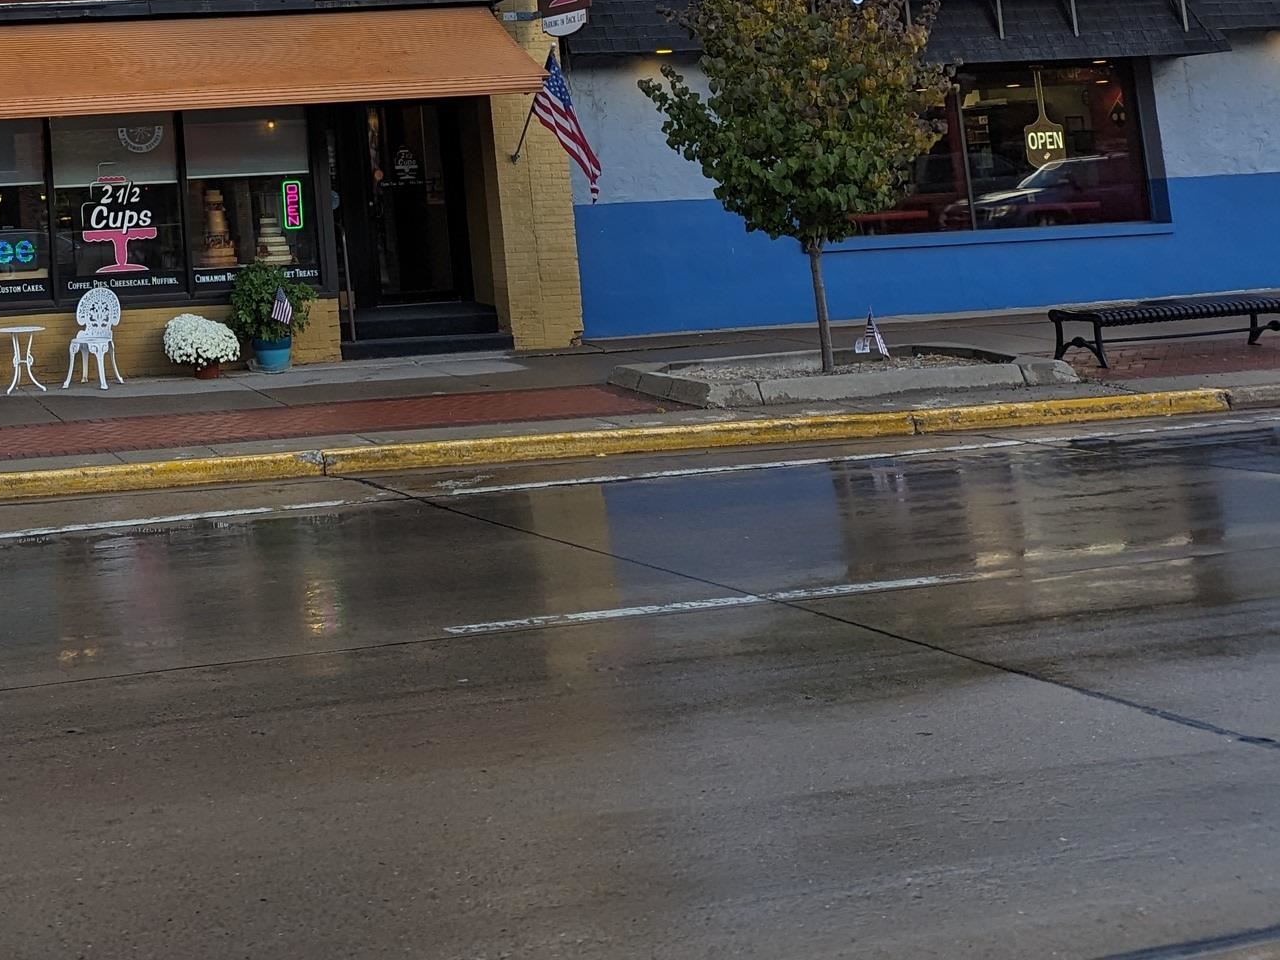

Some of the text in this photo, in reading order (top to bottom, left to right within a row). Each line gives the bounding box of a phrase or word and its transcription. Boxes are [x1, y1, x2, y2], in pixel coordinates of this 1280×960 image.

[1027, 131, 1064, 150] OPEN
[286, 184, 300, 226] OPEN
[90, 205, 153, 234] Cups
[194, 273, 226, 283] CINNAMON
[295, 268, 319, 278] TREATS
